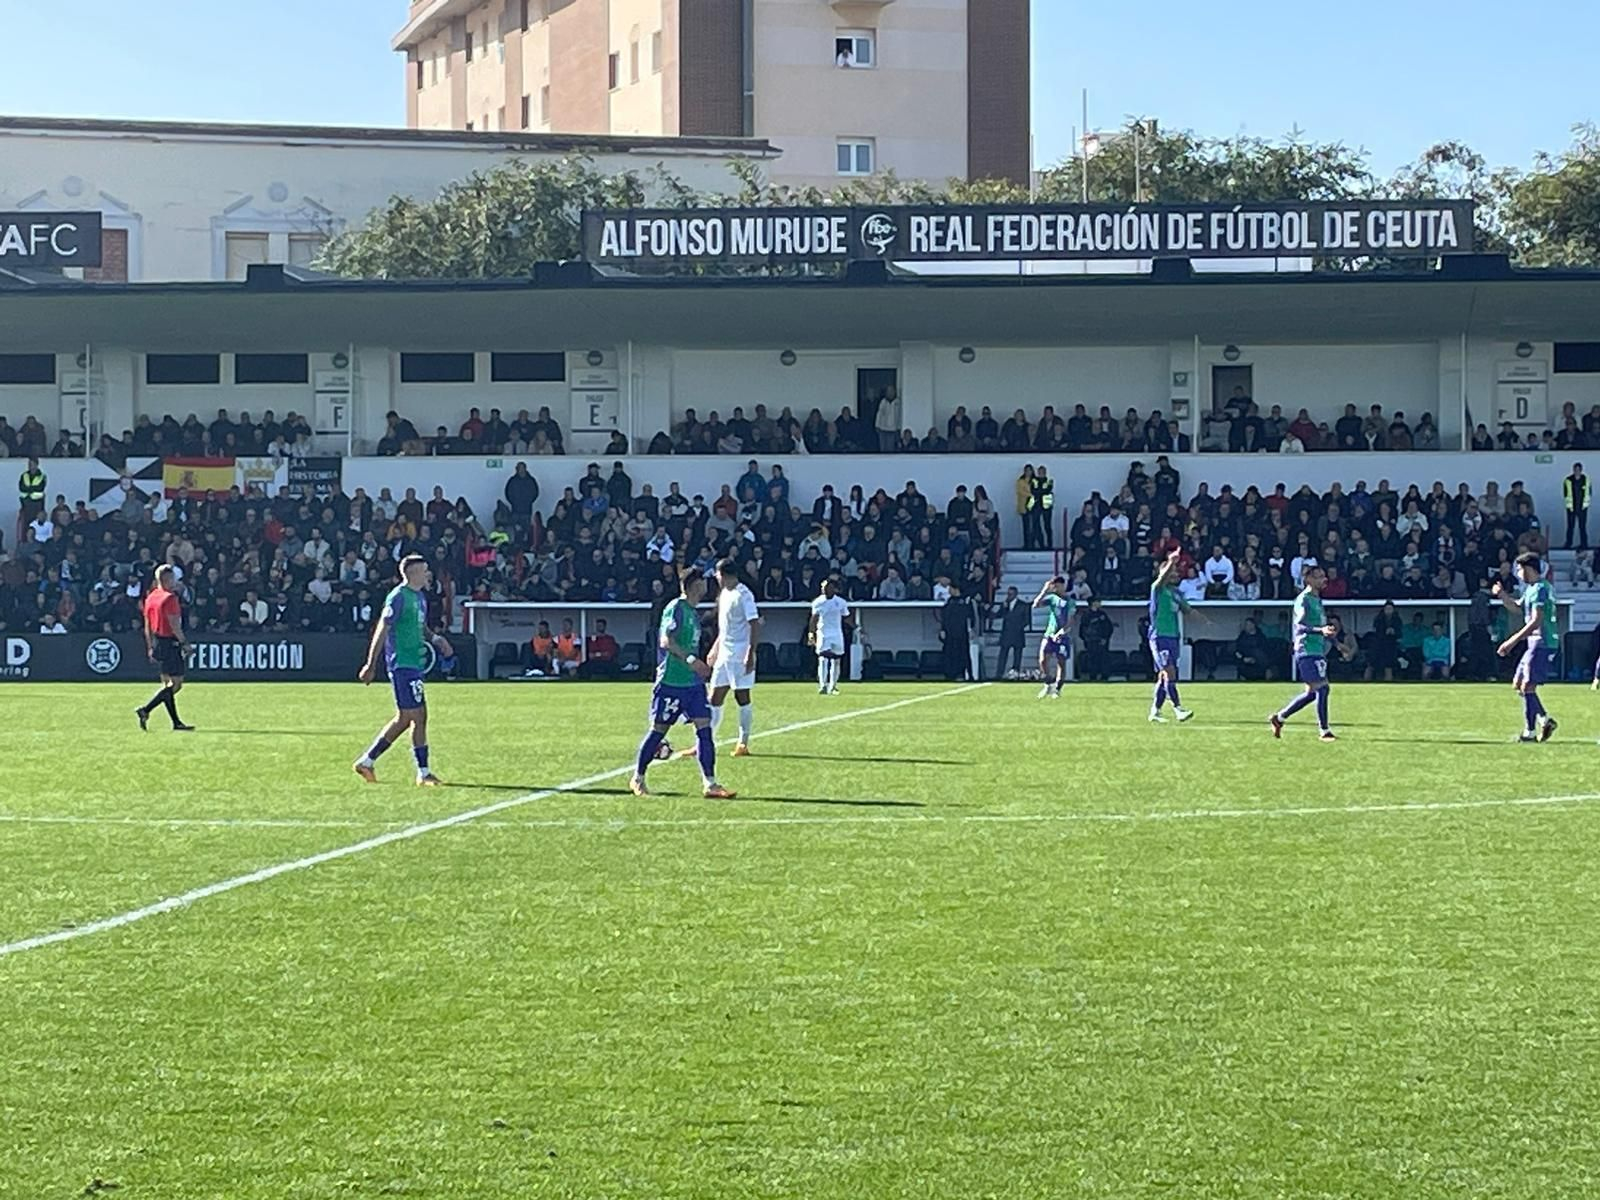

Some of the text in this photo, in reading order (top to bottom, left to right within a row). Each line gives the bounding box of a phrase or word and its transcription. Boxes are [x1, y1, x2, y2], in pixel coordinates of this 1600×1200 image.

[0, 223, 78, 256] AFC
[599, 216, 847, 257] ALFONSO MURUBE
[910, 205, 1458, 253] REAL FEDERACIÓN DE FÚTBOL DE CEUTA
[334, 406, 343, 428] F
[590, 404, 601, 426] E
[6, 638, 31, 665] D
[188, 640, 303, 669] FEDERACIÓN
[663, 697, 680, 713] 14
